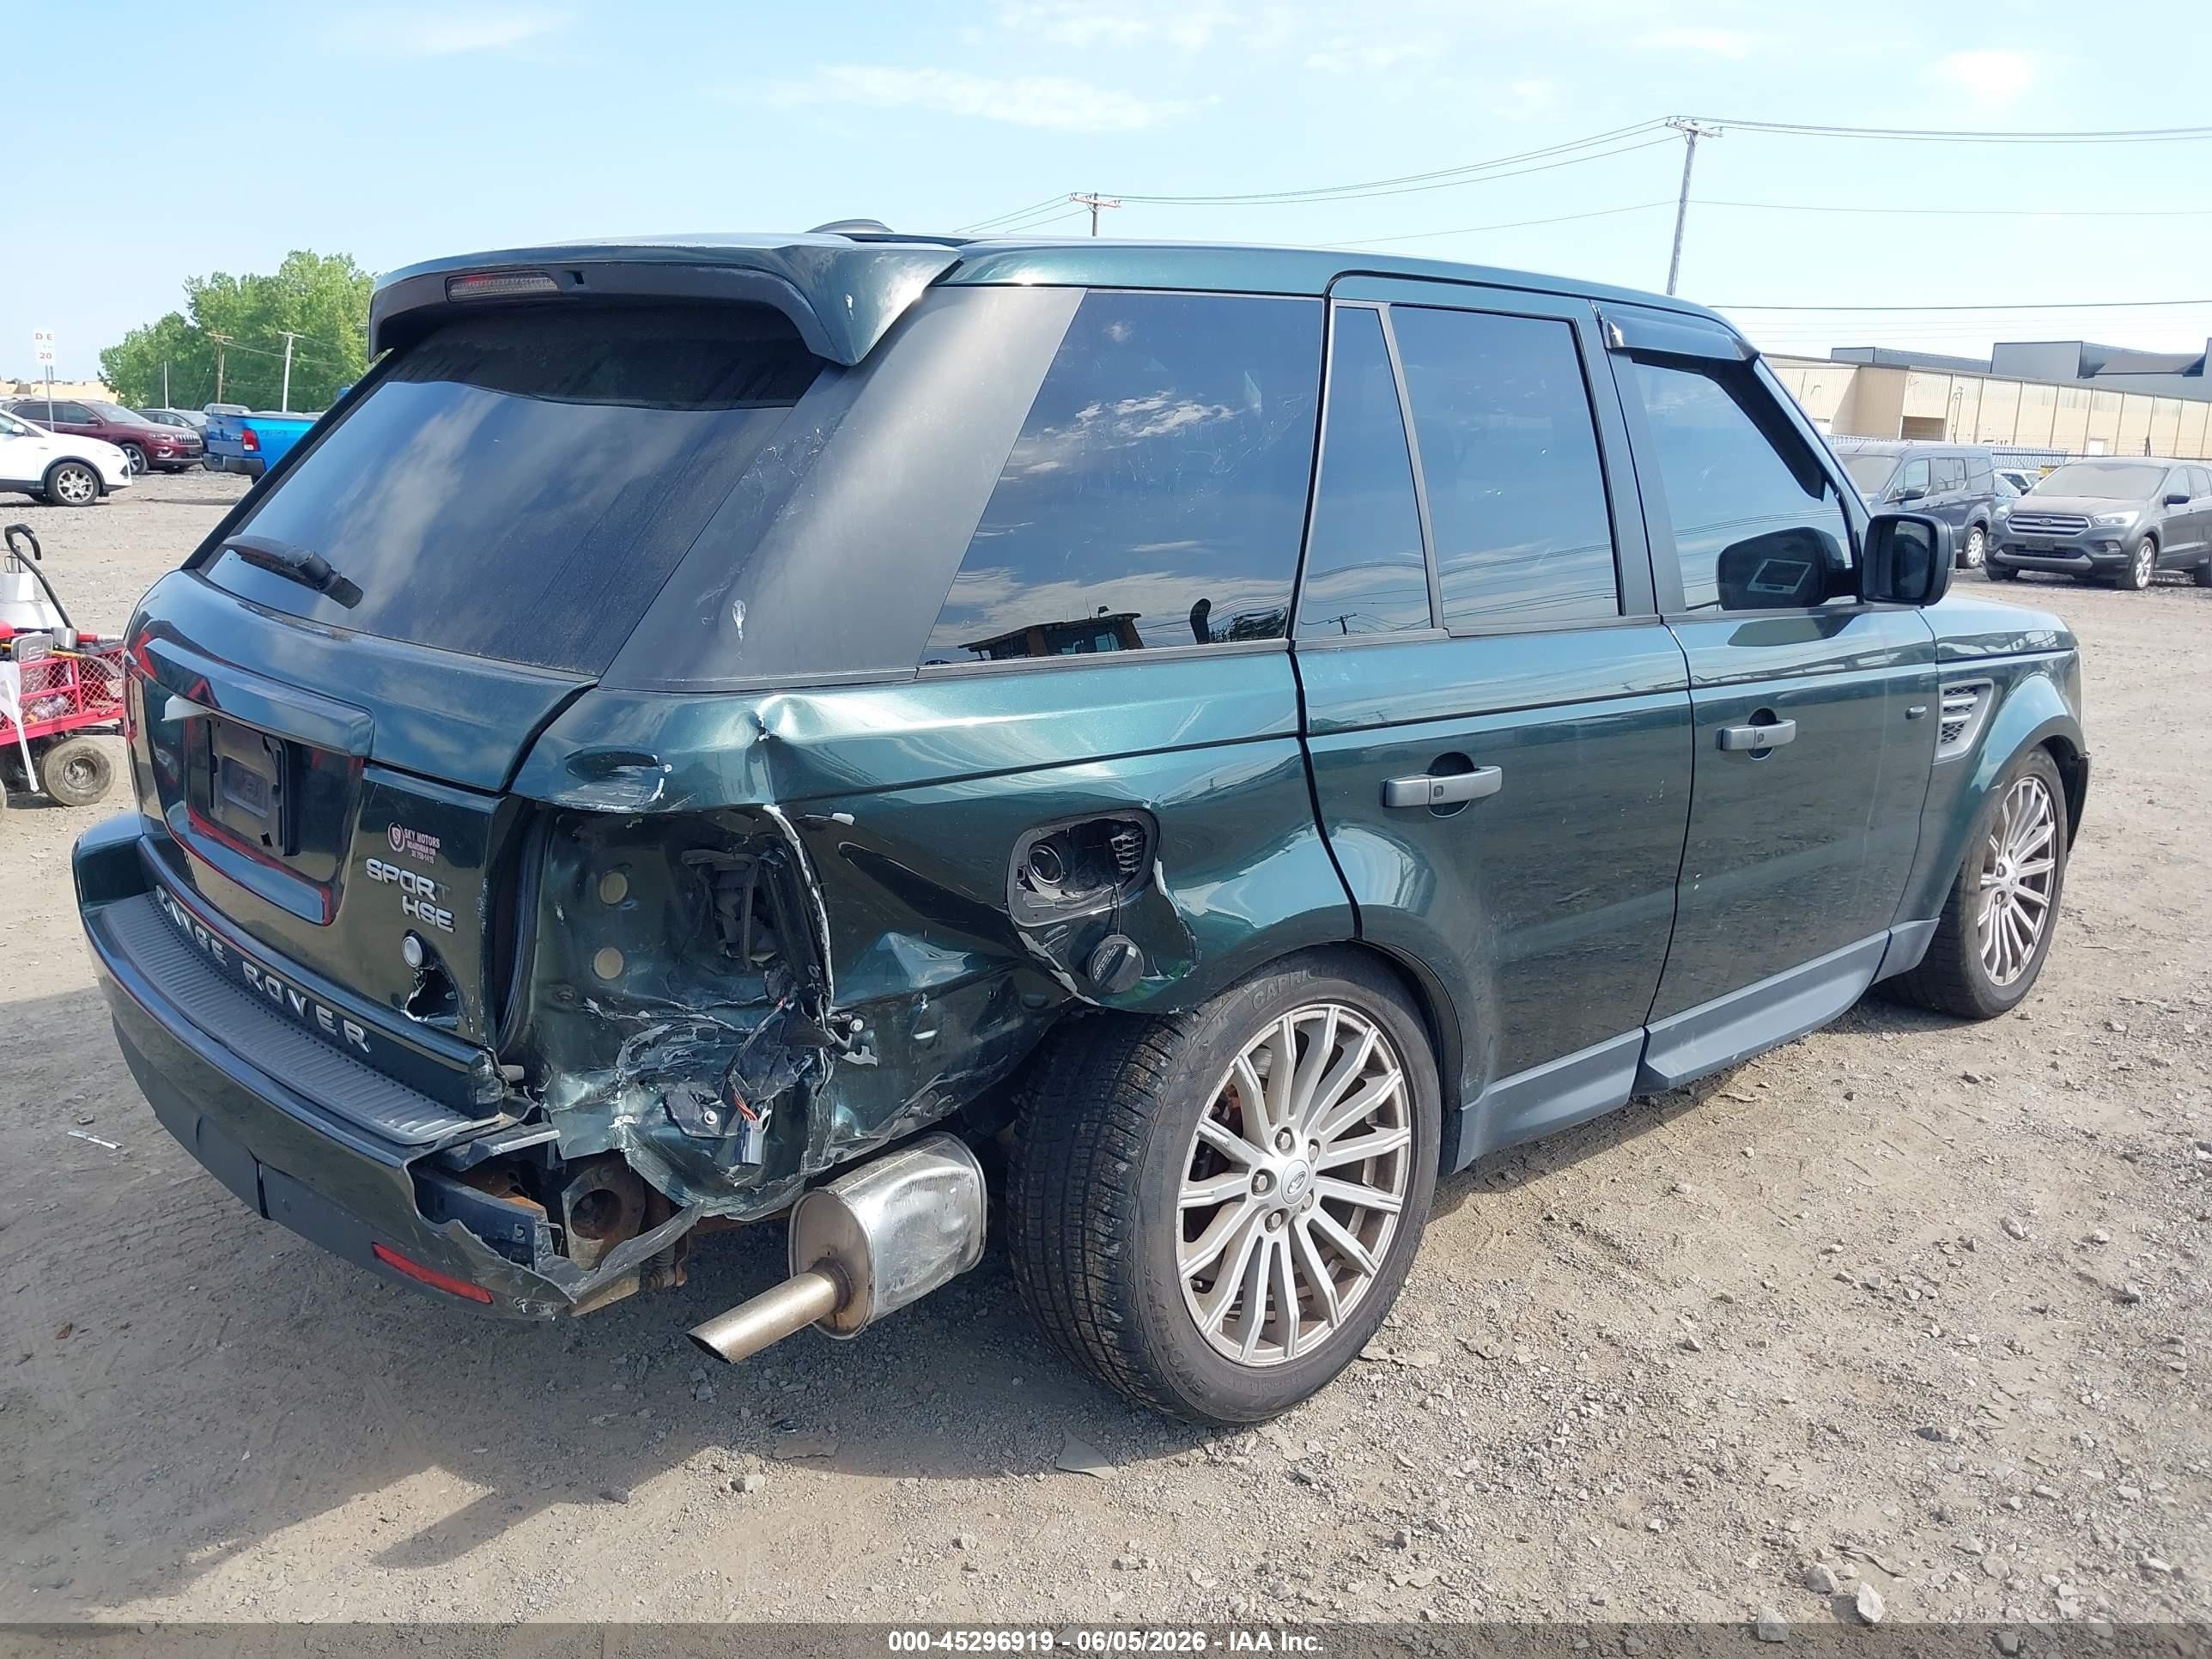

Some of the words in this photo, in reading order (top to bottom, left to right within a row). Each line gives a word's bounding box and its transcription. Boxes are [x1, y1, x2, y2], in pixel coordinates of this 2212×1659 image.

[404, 828, 416, 841] SKY
[416, 831, 441, 849] MOTORS
[402, 895, 455, 933] HSE
[155, 884, 228, 967] RANGE
[242, 961, 372, 1054] ROVER
